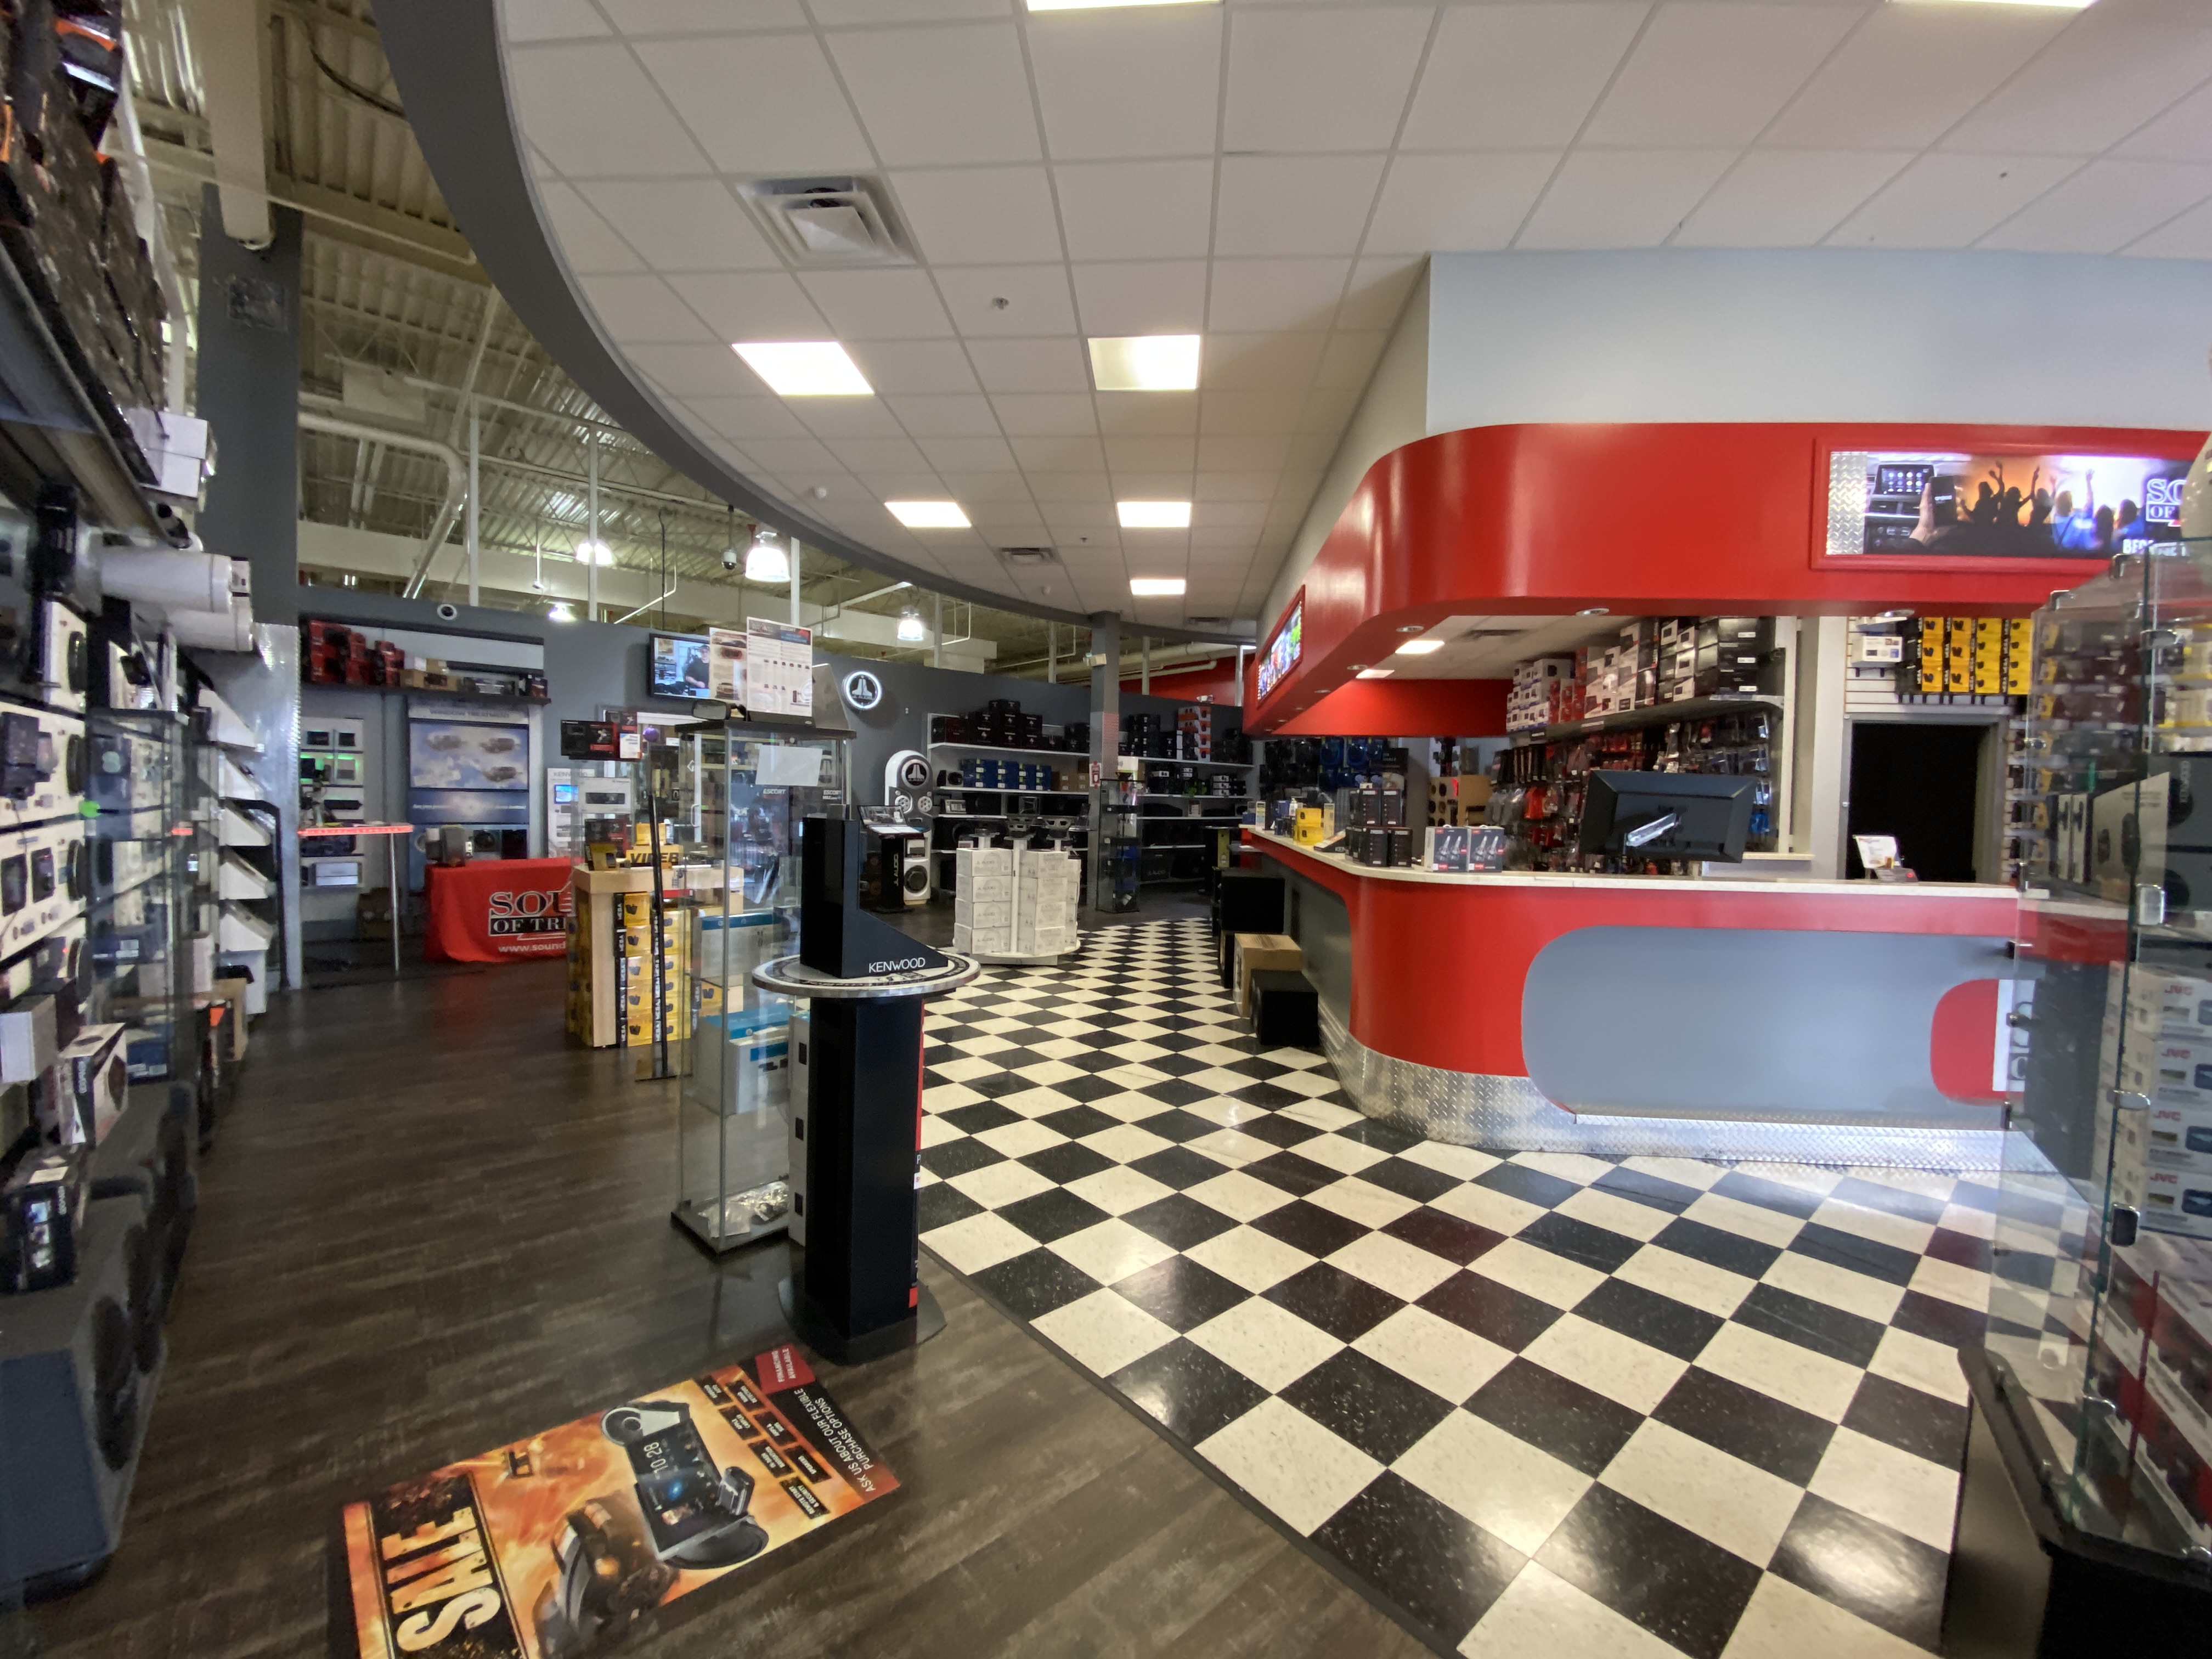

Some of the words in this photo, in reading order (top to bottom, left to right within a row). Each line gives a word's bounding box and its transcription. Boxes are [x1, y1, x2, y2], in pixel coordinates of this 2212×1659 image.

[2150, 506, 2175, 518] OF
[493, 919, 524, 933] OF
[530, 917, 566, 932] TRI
[498, 941, 566, 953] www.sound
[868, 957, 926, 973] KENWOOD
[2164, 985, 2193, 995] JVC
[2160, 1048, 2191, 1059] JVC
[2153, 1110, 2181, 1121] JVC
[2149, 1173, 2178, 1184] JVC
[771, 1350, 785, 1383] FINANCING
[782, 1347, 797, 1380] AVAILABLE
[793, 1388, 823, 1420] FLEXIBLE
[815, 1397, 843, 1429] OPTIONS
[817, 1419, 834, 1436] OUR
[828, 1437, 853, 1463] ABOUT
[837, 1427, 874, 1470] PURCHASE
[848, 1464, 862, 1476] US
[856, 1476, 876, 1493] ASK
[797, 1485, 816, 1504] SECURITY
[381, 1506, 501, 1652] SALE
